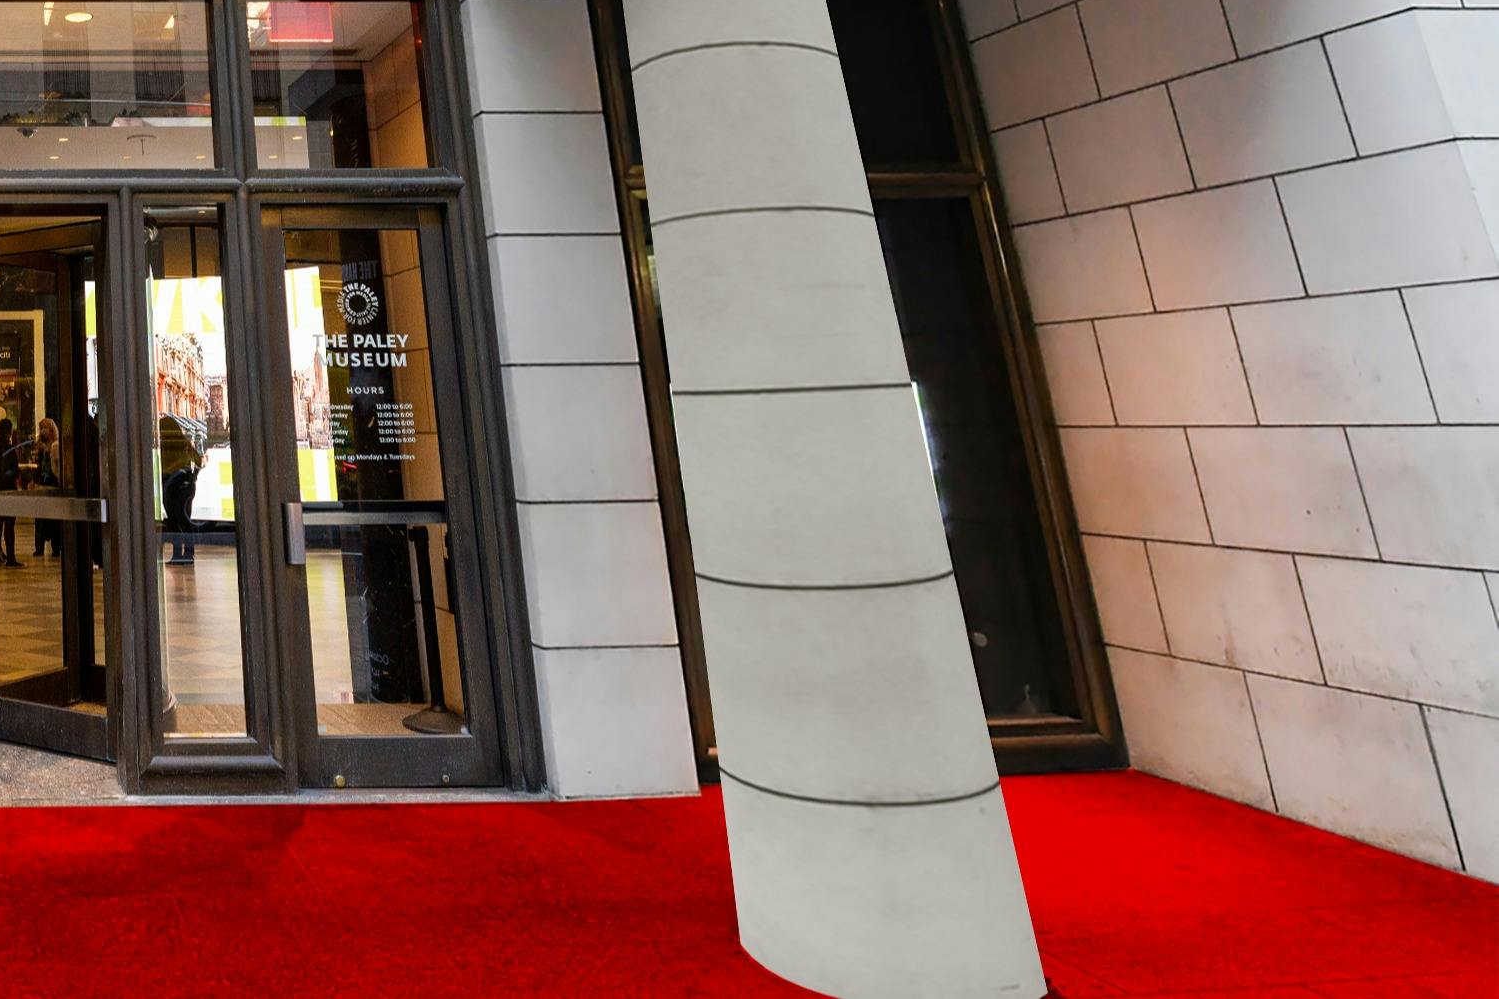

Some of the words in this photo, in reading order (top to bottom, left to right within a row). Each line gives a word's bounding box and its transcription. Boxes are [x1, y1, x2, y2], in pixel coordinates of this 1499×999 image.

[343, 282, 359, 293] THE
[360, 283, 379, 307] PALEY
[312, 334, 348, 349] THE
[353, 334, 409, 349] PALEY
[318, 352, 407, 367] MUSEUM
[346, 386, 384, 395] HOURS
[356, 454, 383, 462] Mondays
